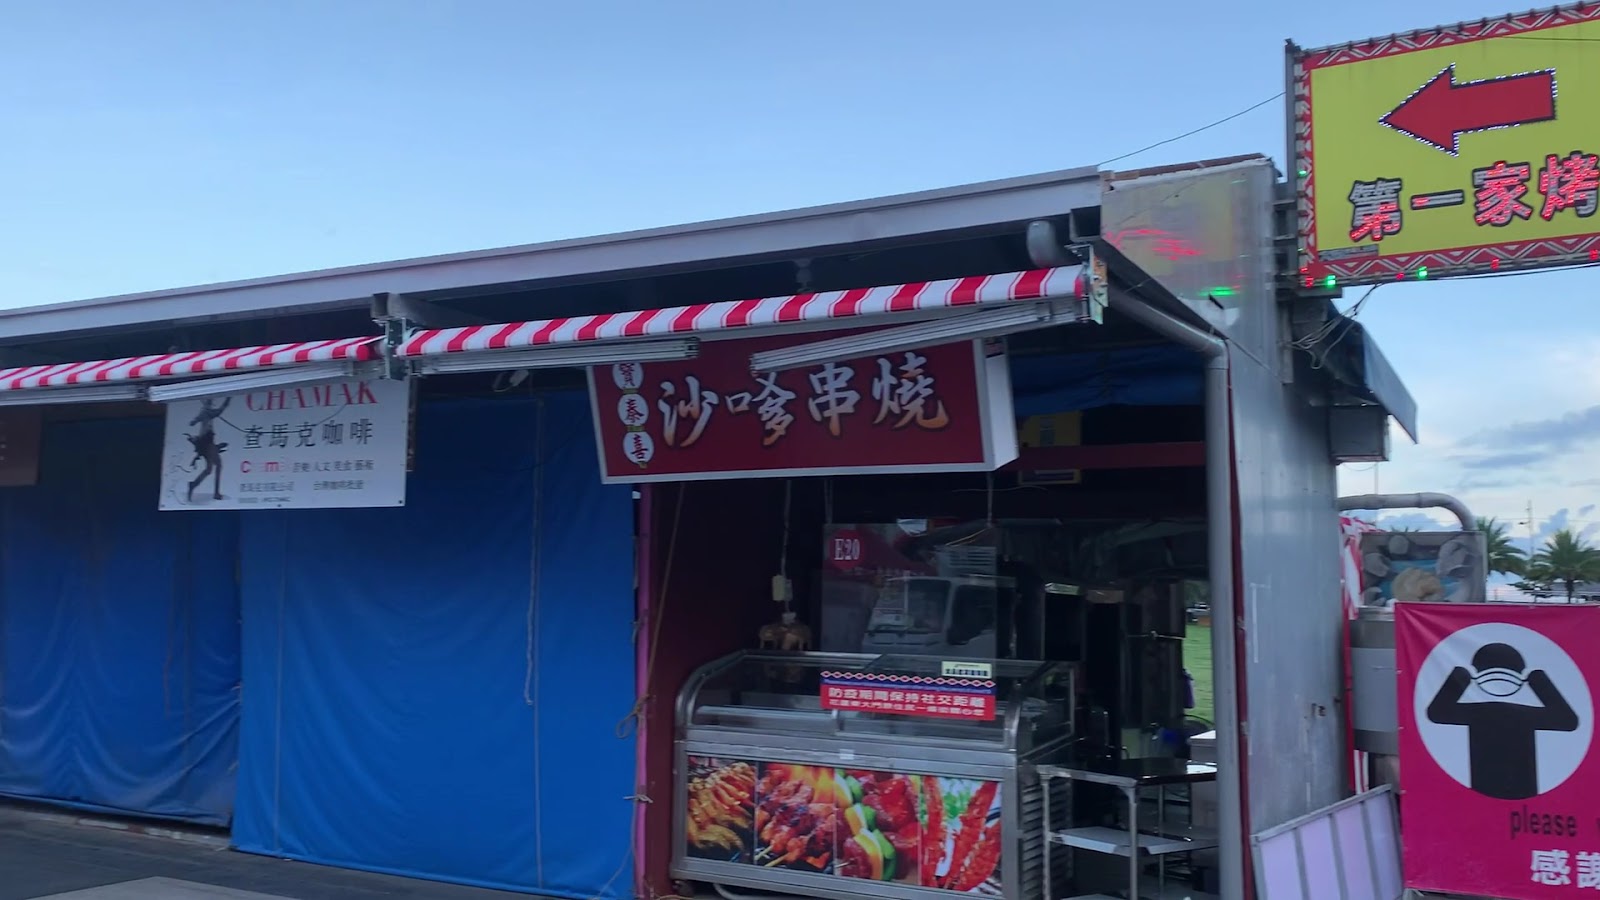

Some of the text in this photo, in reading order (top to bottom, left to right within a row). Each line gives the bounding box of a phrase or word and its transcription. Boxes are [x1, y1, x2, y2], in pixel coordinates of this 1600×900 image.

[1347, 151, 1600, 242] 第一家烤
[657, 352, 949, 447] 沙嗲串燒
[242, 418, 373, 450] 查馬克咖啡
[833, 538, 861, 561] E20
[828, 687, 986, 709] 防疫期間保持社交距離
[1510, 804, 1577, 840] please
